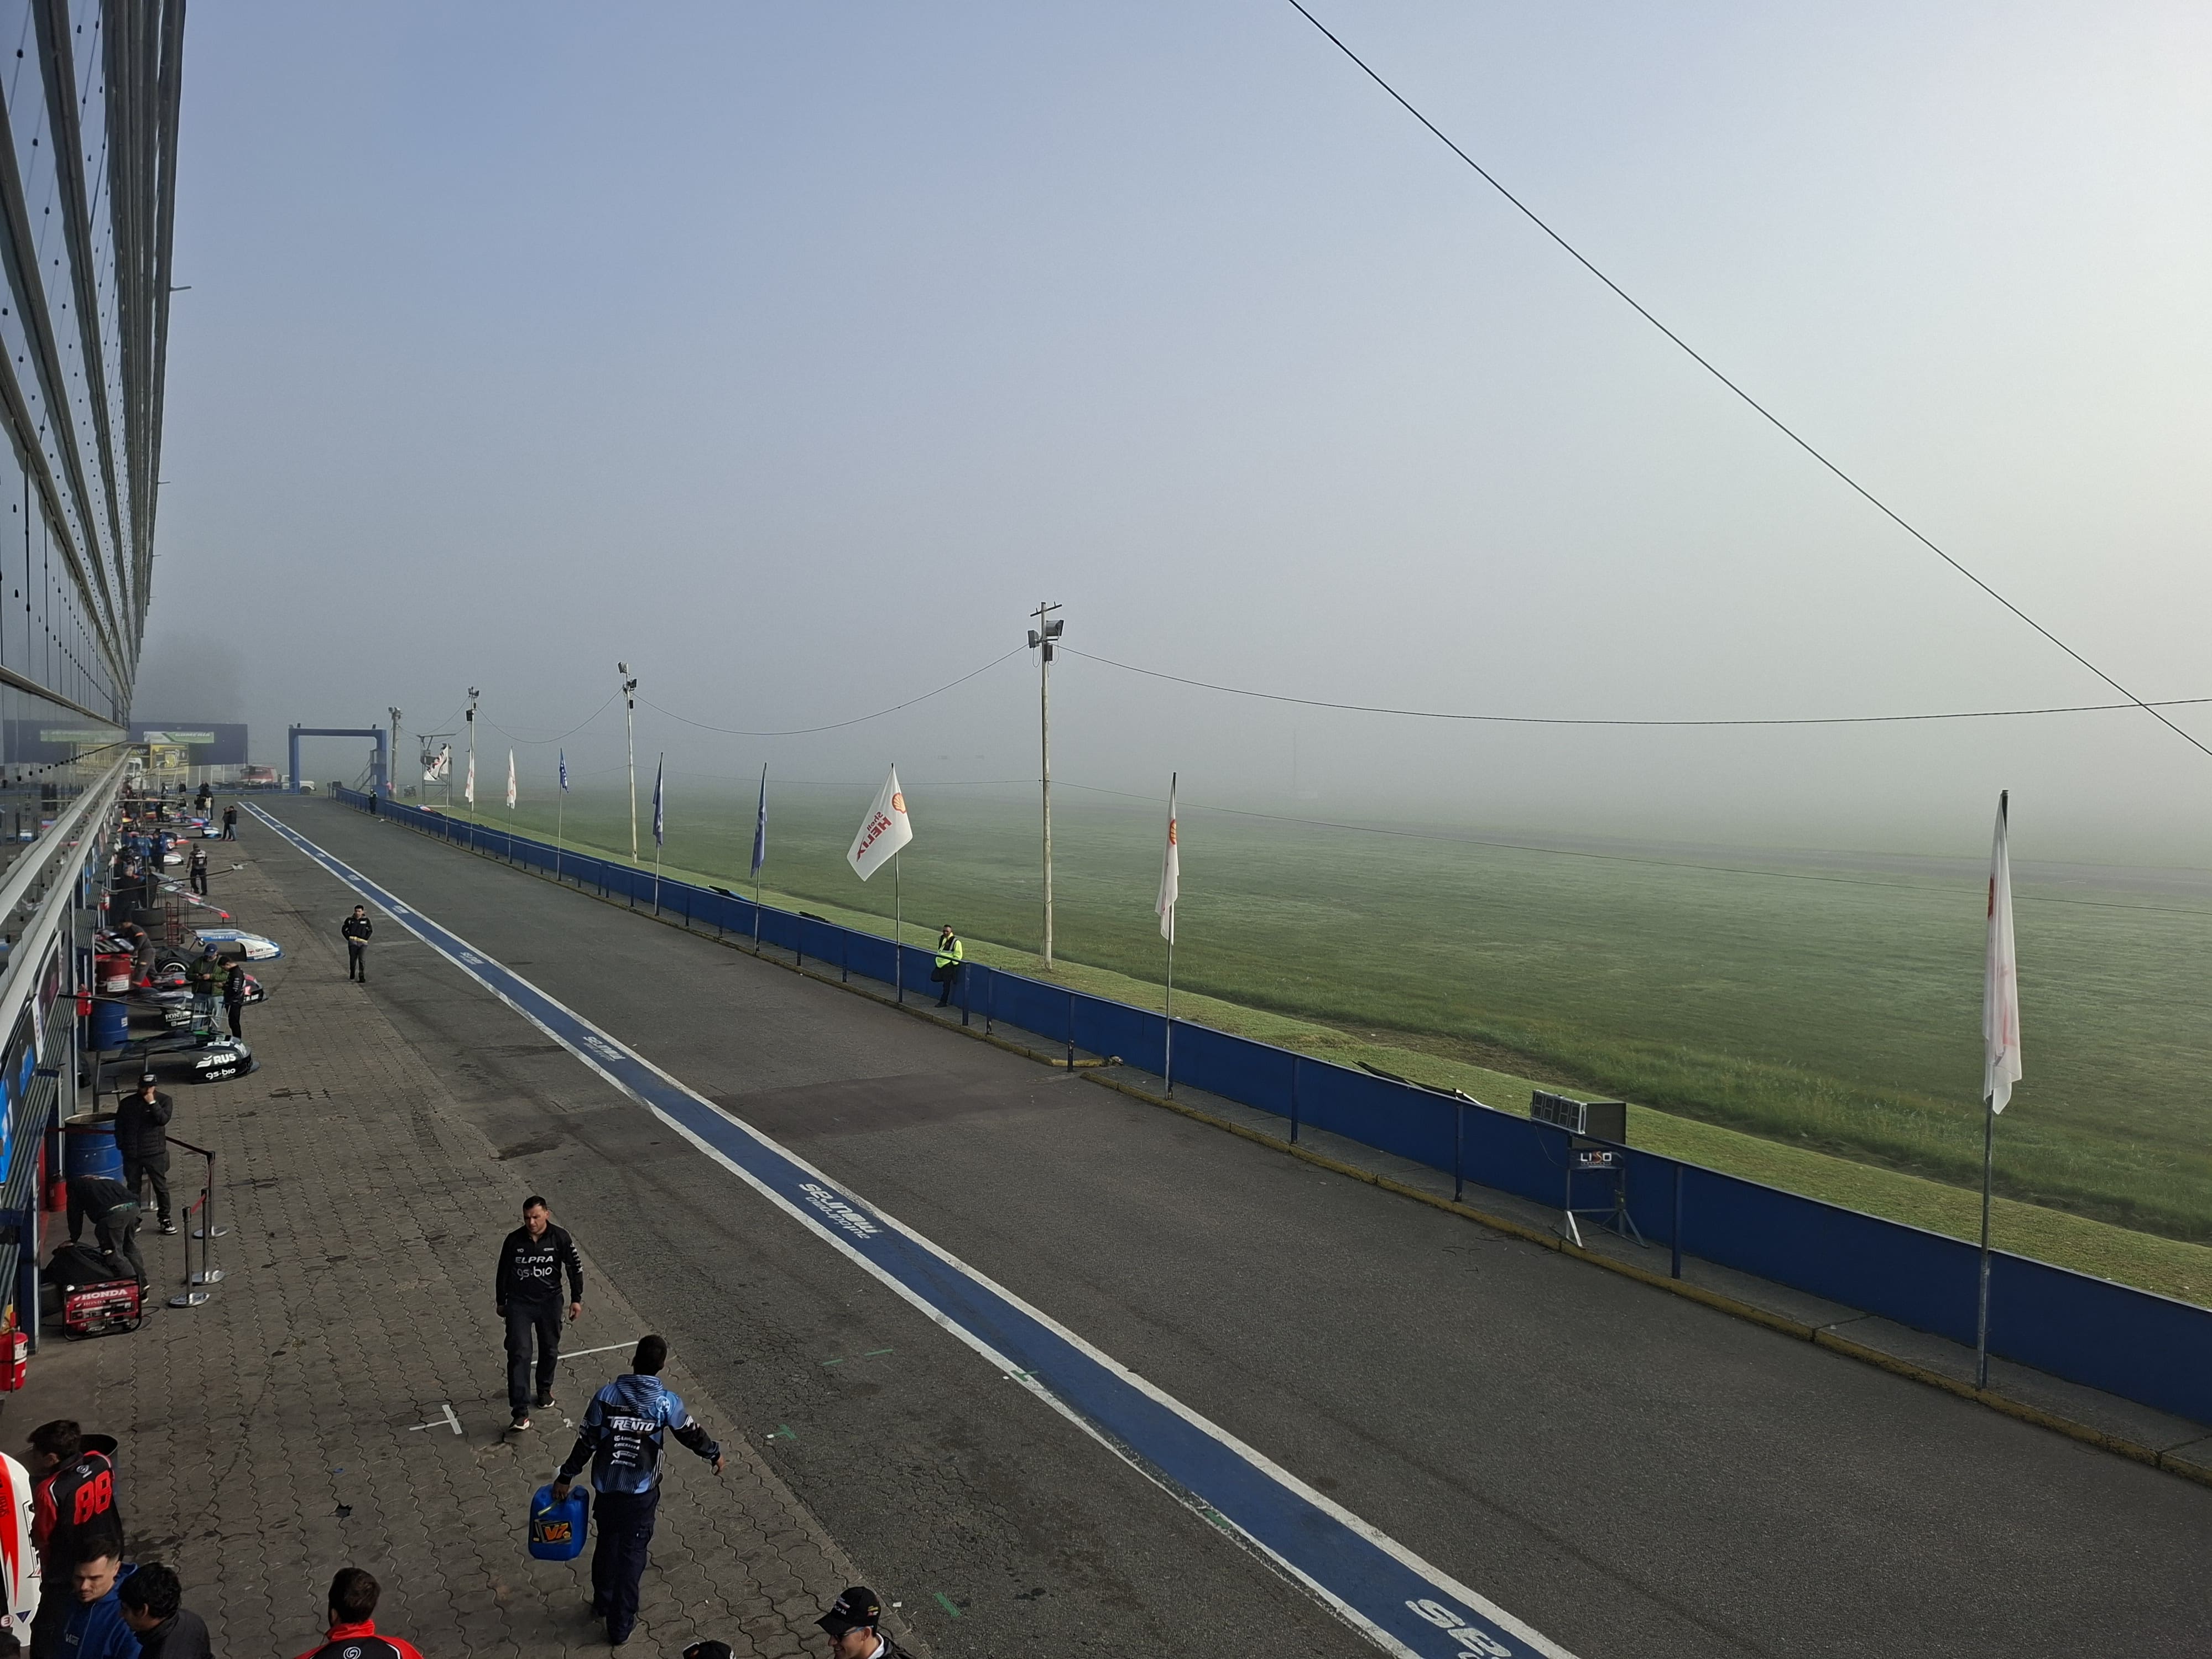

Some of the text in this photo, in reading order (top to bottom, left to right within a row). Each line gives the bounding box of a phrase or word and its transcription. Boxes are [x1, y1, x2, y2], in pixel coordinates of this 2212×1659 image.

[213, 1053, 237, 1065] RUS
[515, 1255, 554, 1264] ELPRA
[82, 1289, 127, 1300] HONDA
[607, 1416, 657, 1432] TRENTO
[74, 1469, 113, 1525] 88
